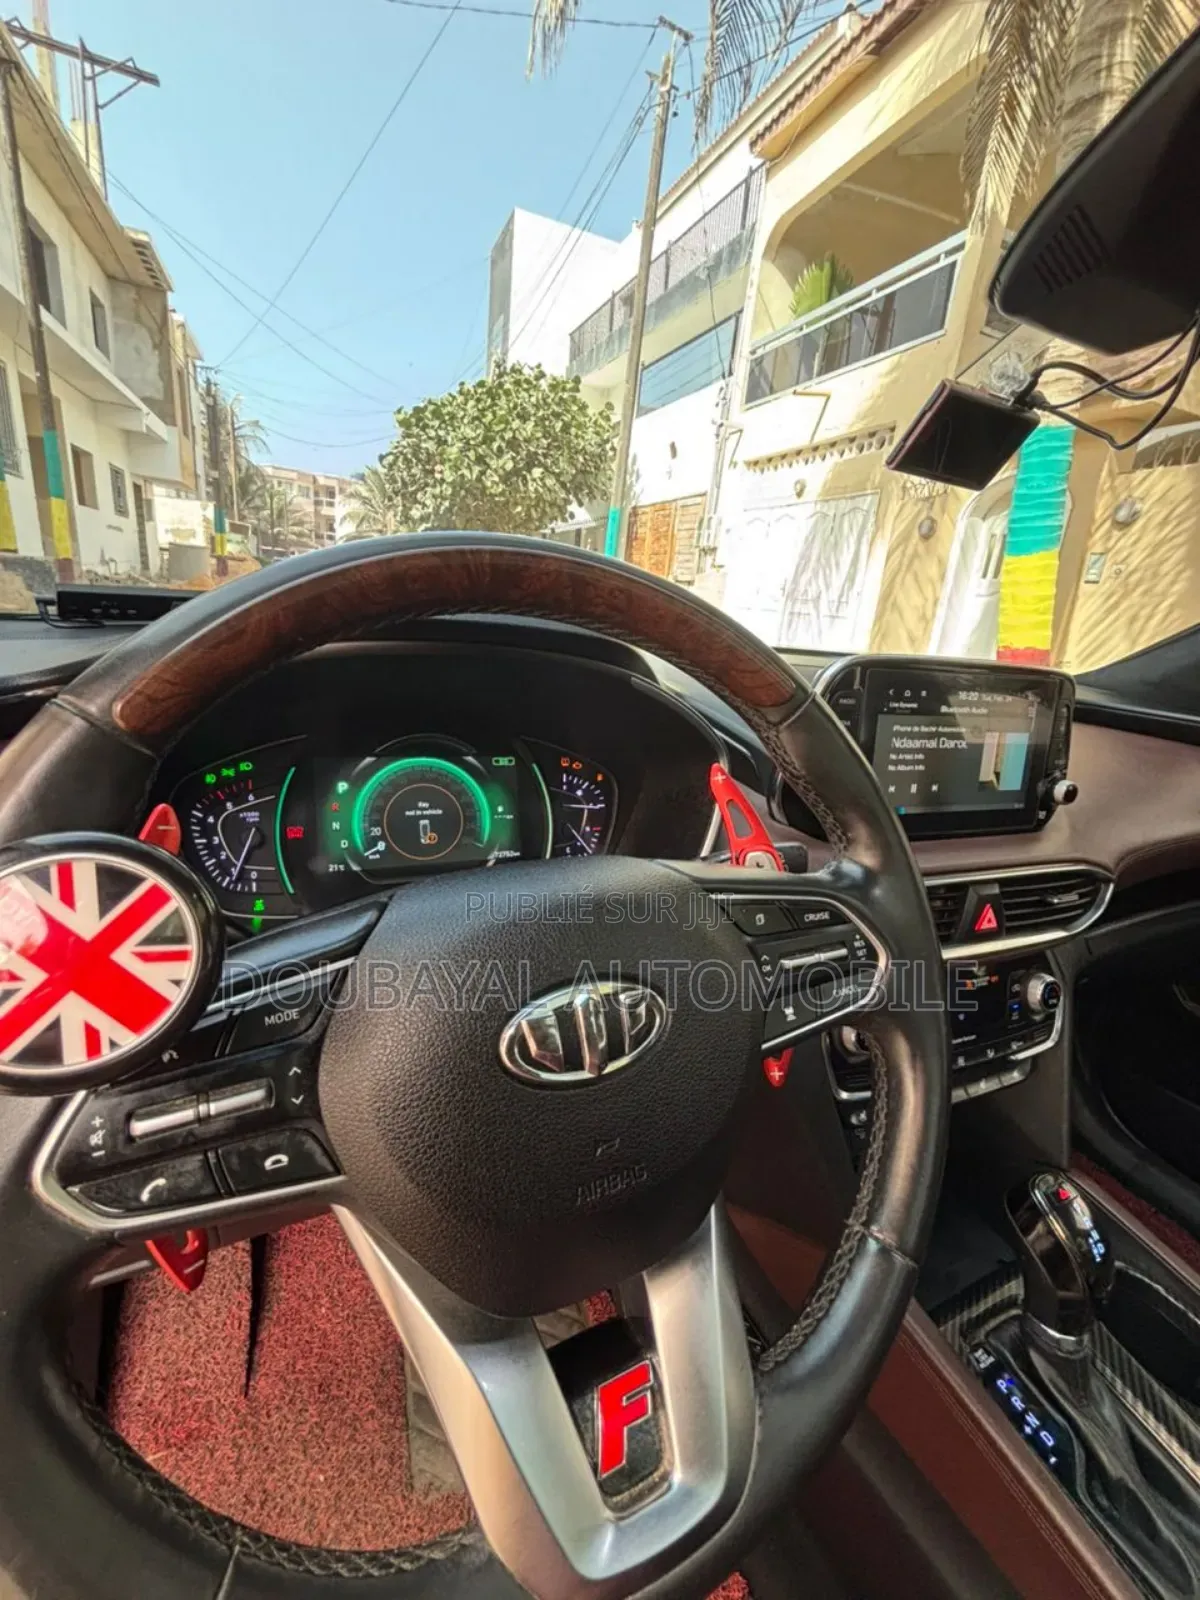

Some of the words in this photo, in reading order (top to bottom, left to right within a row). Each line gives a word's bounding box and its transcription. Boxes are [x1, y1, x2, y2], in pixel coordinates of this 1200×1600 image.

[337, 782, 349, 794] P
[247, 793, 255, 801] 6
[225, 801, 233, 810] 5
[207, 815, 215, 824] 4
[332, 822, 340, 830] N
[370, 827, 382, 836] 20
[212, 836, 220, 845] 3
[340, 840, 349, 849] D
[220, 850, 227, 860] 2
[250, 871, 258, 879] 0
[804, 911, 831, 922] CRUISE
[264, 1008, 301, 1026] MODE
[576, 1164, 648, 1206] AIRBAG
[996, 1379, 1009, 1394] P
[1011, 1396, 1026, 1411] R
[1025, 1411, 1040, 1429] N
[1040, 1430, 1055, 1447] D
[594, 1359, 654, 1480] F
